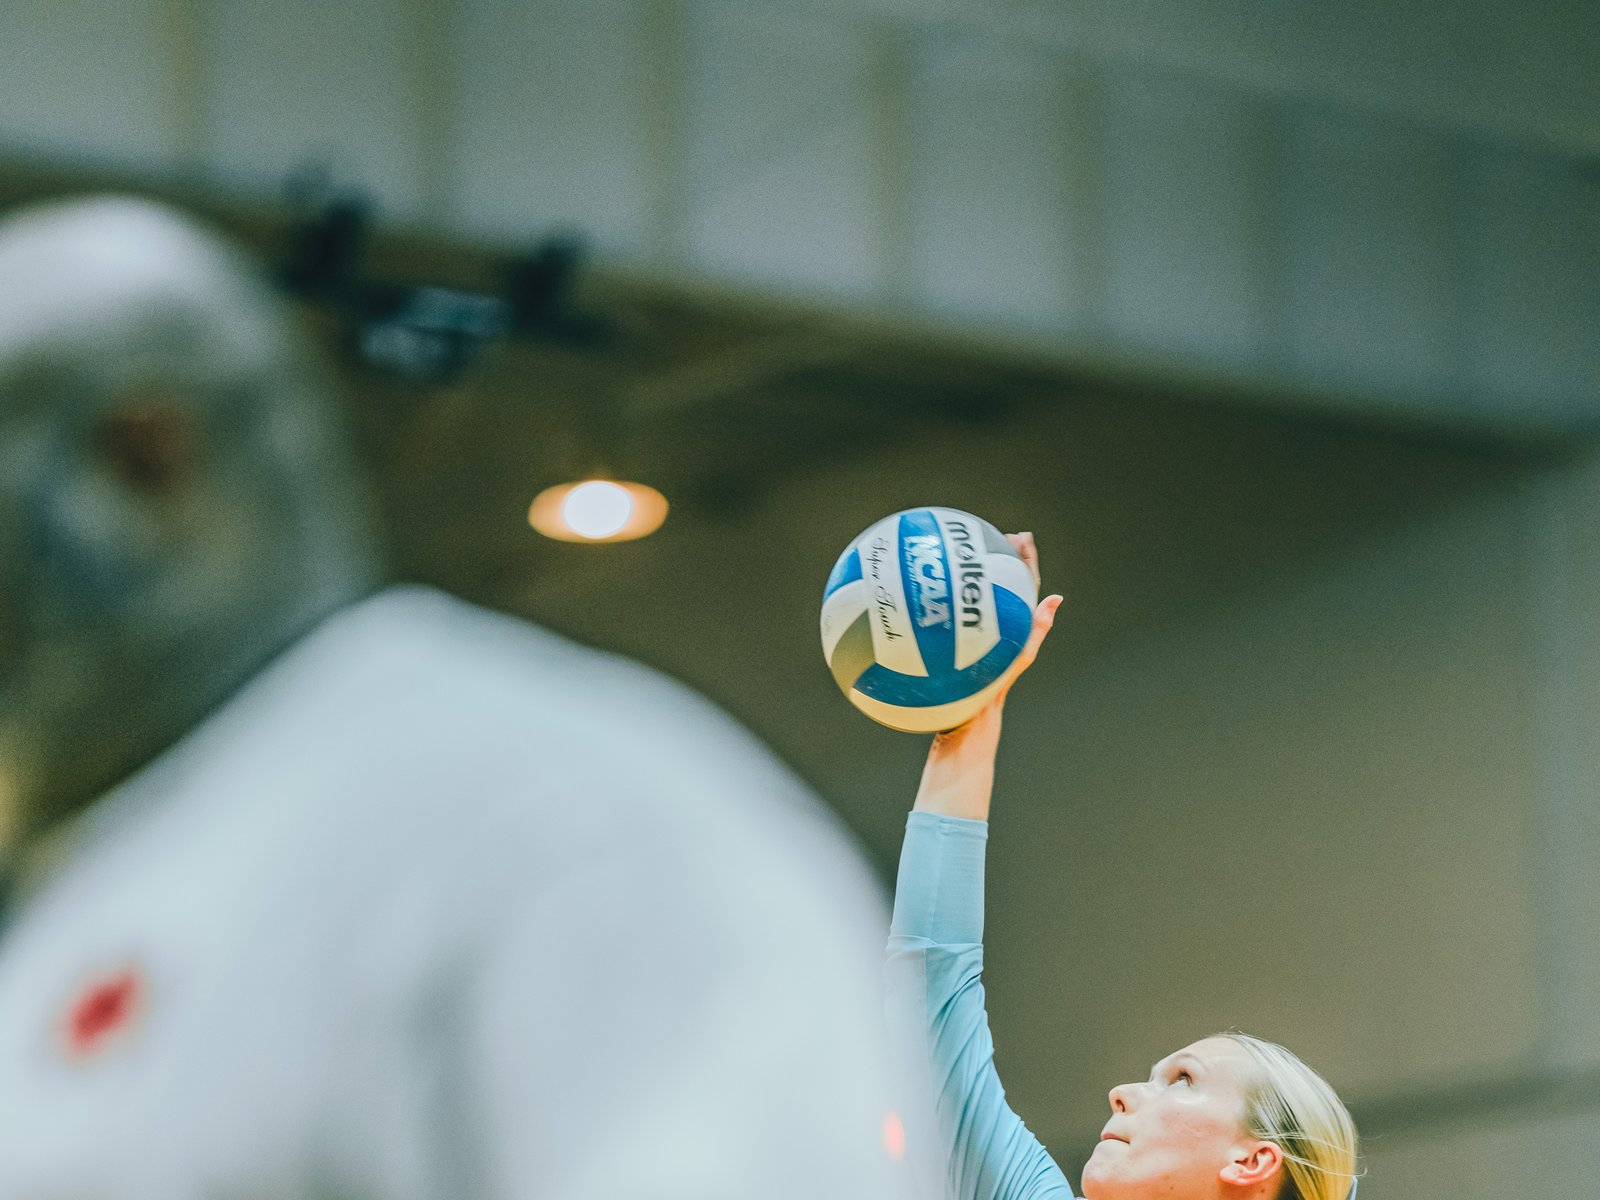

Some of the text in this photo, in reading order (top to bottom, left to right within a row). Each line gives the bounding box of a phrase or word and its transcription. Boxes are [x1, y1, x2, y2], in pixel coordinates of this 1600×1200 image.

[867, 537, 903, 642] Super Touch
[904, 534, 951, 628] NCAA
[945, 521, 984, 628] molten
